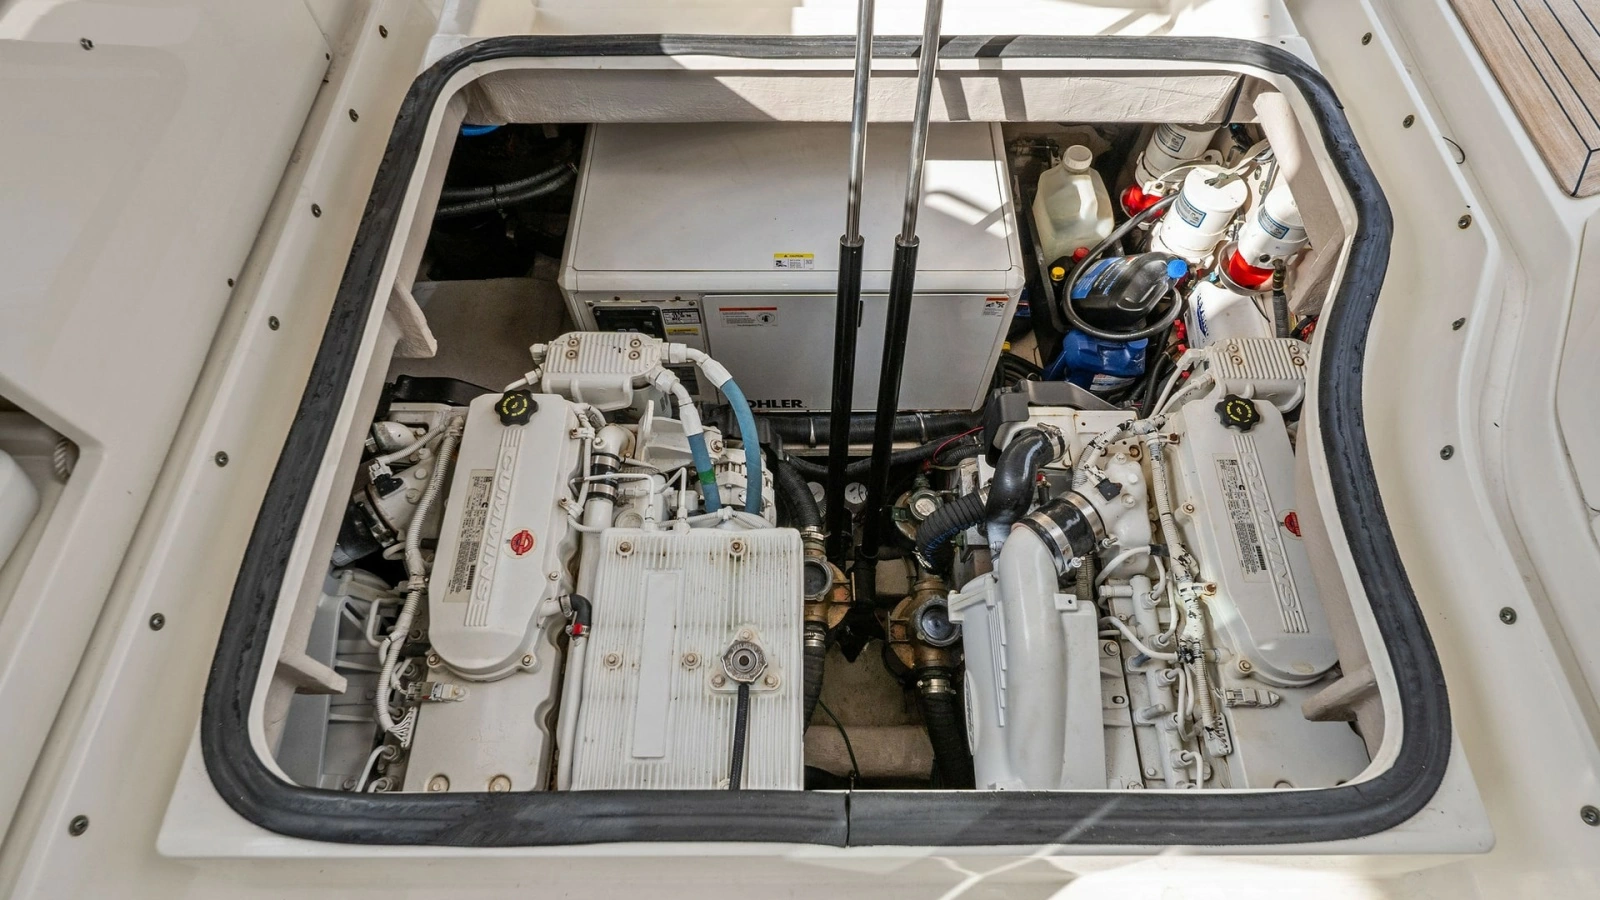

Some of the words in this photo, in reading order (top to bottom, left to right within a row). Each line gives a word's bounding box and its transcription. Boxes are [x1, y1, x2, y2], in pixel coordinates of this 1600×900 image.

[746, 399, 804, 409] OHLER
[476, 453, 513, 601] CUMMINS
[1245, 458, 1296, 608] CUMMINS
